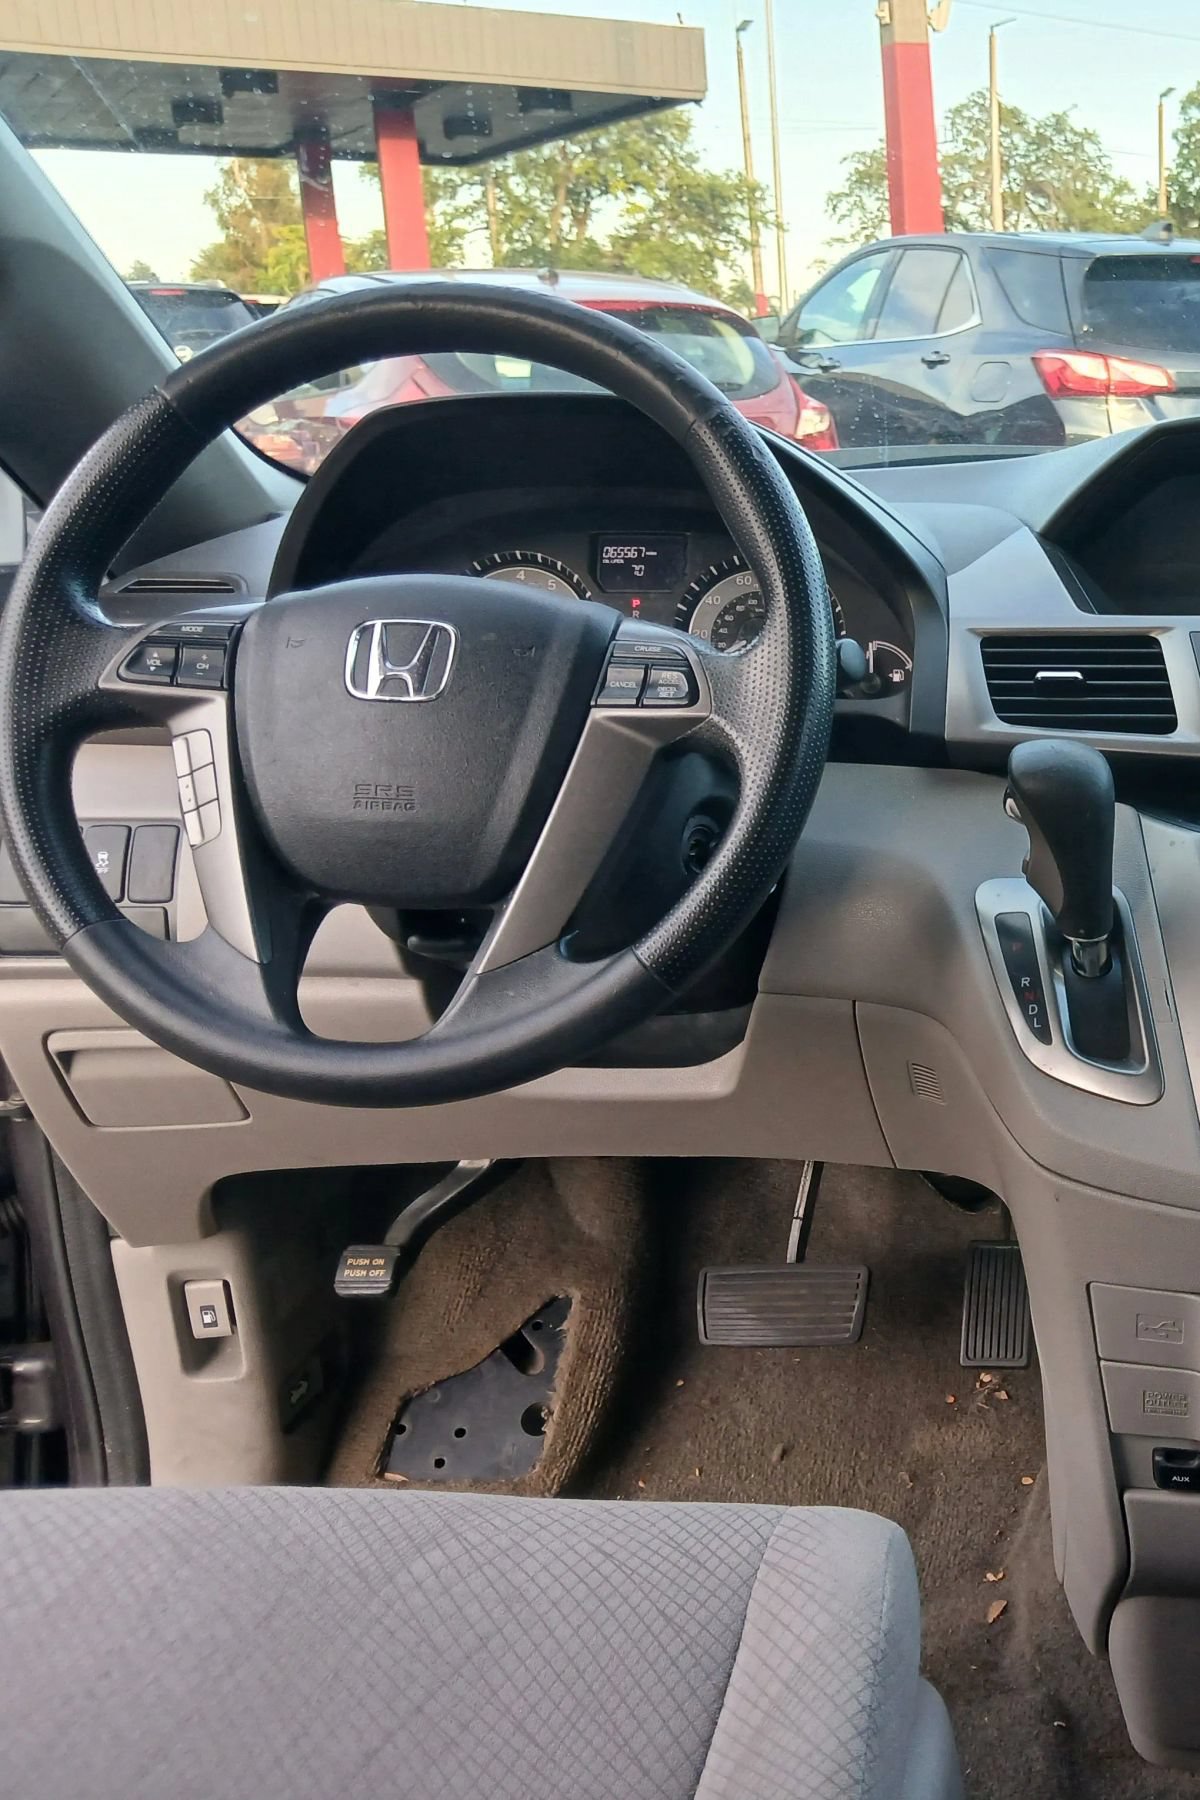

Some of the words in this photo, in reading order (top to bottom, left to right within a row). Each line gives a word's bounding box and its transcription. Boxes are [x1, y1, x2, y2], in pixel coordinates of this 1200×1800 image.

[602, 546, 646, 558] 065567
[516, 570, 526, 580] 4
[736, 575, 752, 585] 60
[547, 579, 556, 591] 5
[632, 599, 641, 608] P
[705, 595, 721, 605] 40
[632, 609, 640, 619] R
[146, 658, 162, 666] VOL
[196, 662, 210, 670] CH
[1021, 977, 1031, 988] R
[1028, 1004, 1038, 1015] D
[1033, 1018, 1042, 1028] L
[346, 1258, 370, 1266] PUSH
[372, 1258, 385, 1266] ON
[343, 1269, 367, 1278] PUSH
[368, 1269, 386, 1277] OFF
[1171, 1475, 1190, 1483] AUX
